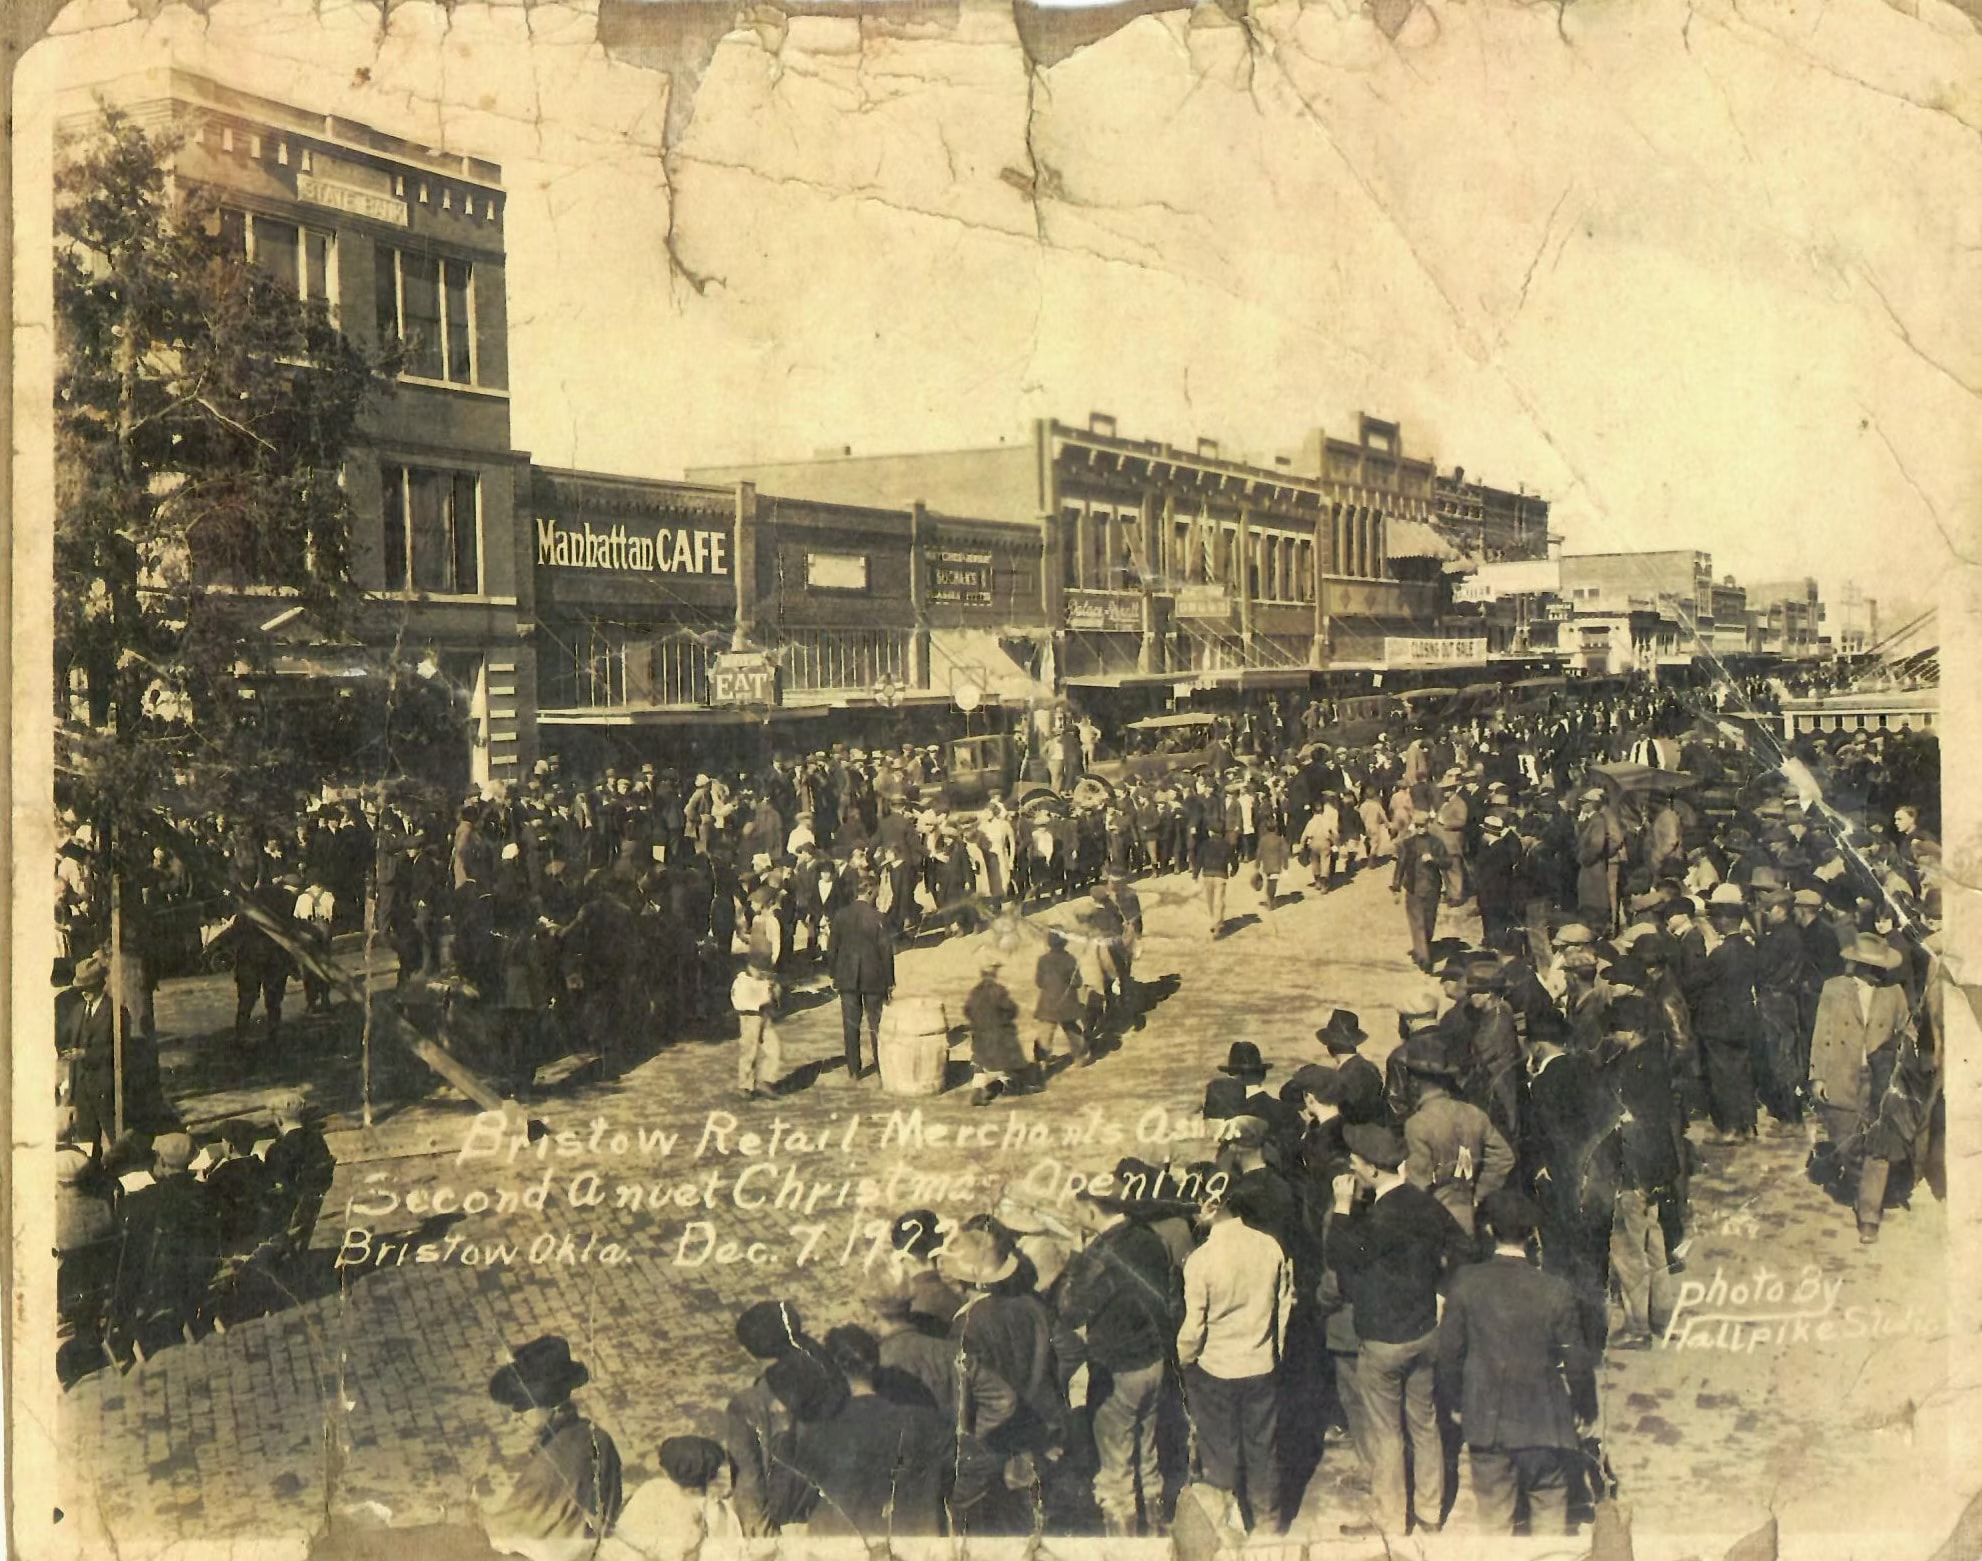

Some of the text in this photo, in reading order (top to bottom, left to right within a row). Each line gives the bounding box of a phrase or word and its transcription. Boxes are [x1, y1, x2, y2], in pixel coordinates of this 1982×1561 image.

[536, 518, 728, 575] Manhattan CAFE
[716, 673, 768, 700] EAT
